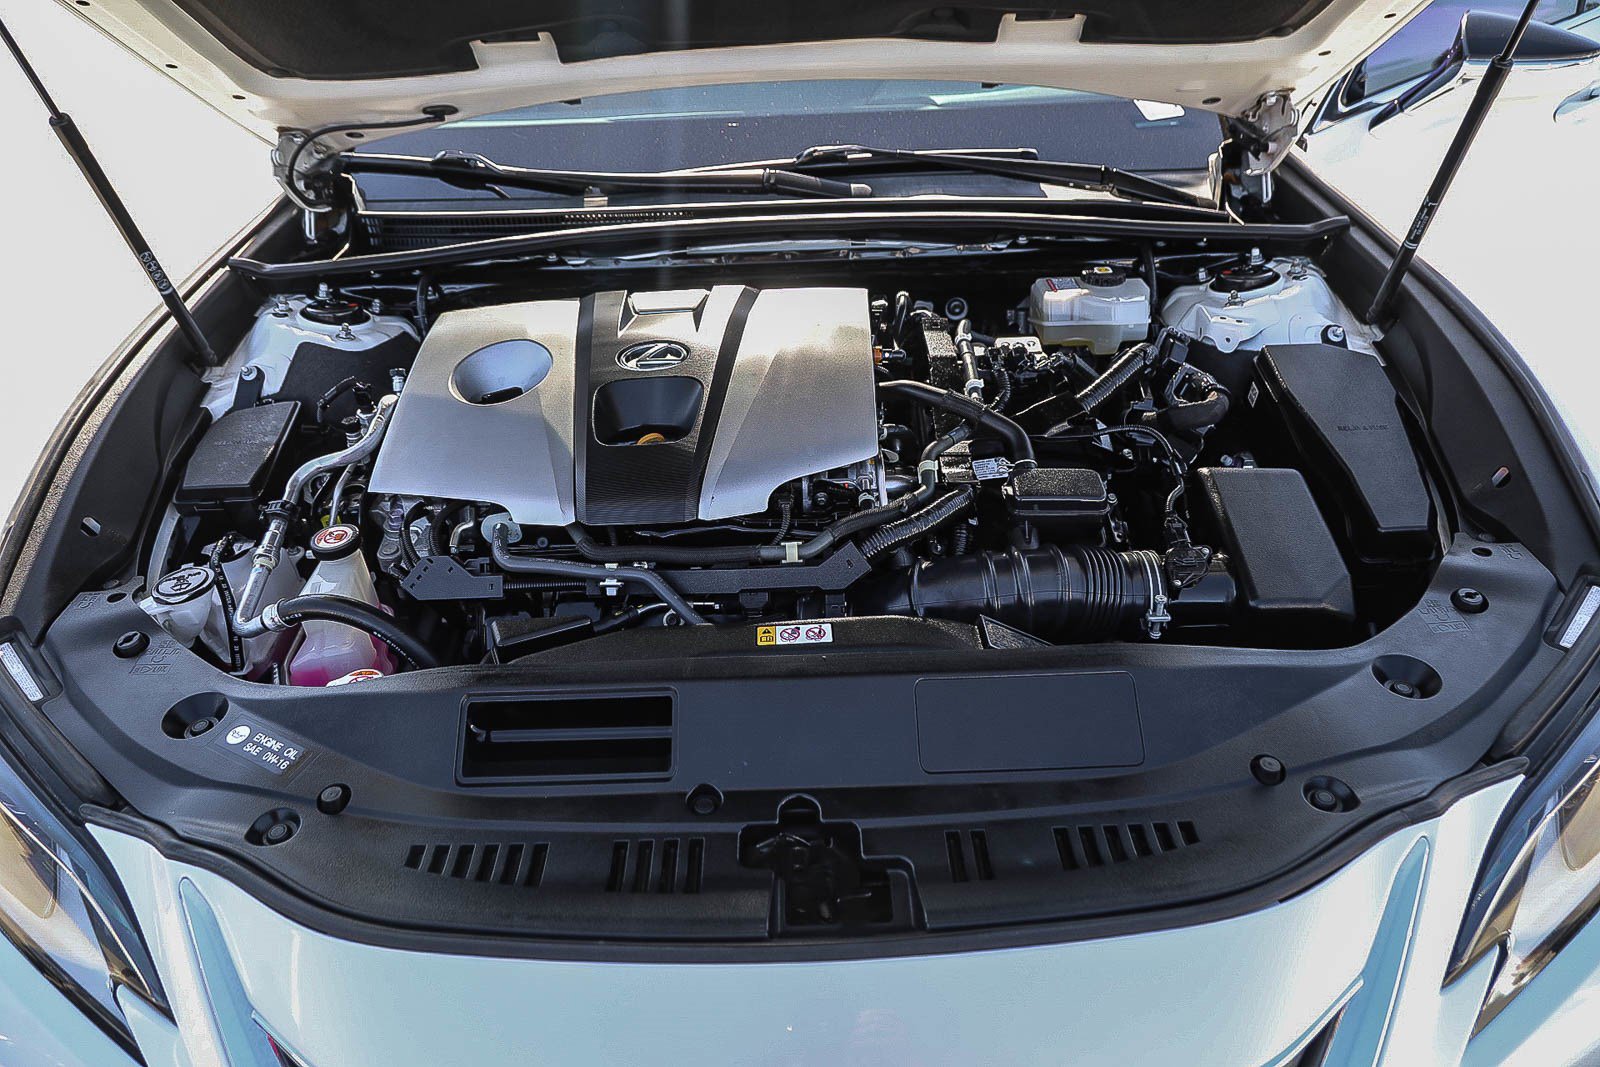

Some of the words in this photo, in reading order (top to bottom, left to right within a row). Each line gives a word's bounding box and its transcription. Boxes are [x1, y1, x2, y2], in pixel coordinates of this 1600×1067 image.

[243, 743, 263, 756] SAE
[262, 752, 290, 770] 0W-16
[253, 733, 284, 751] ENGINE
[283, 747, 299, 760] OIL
